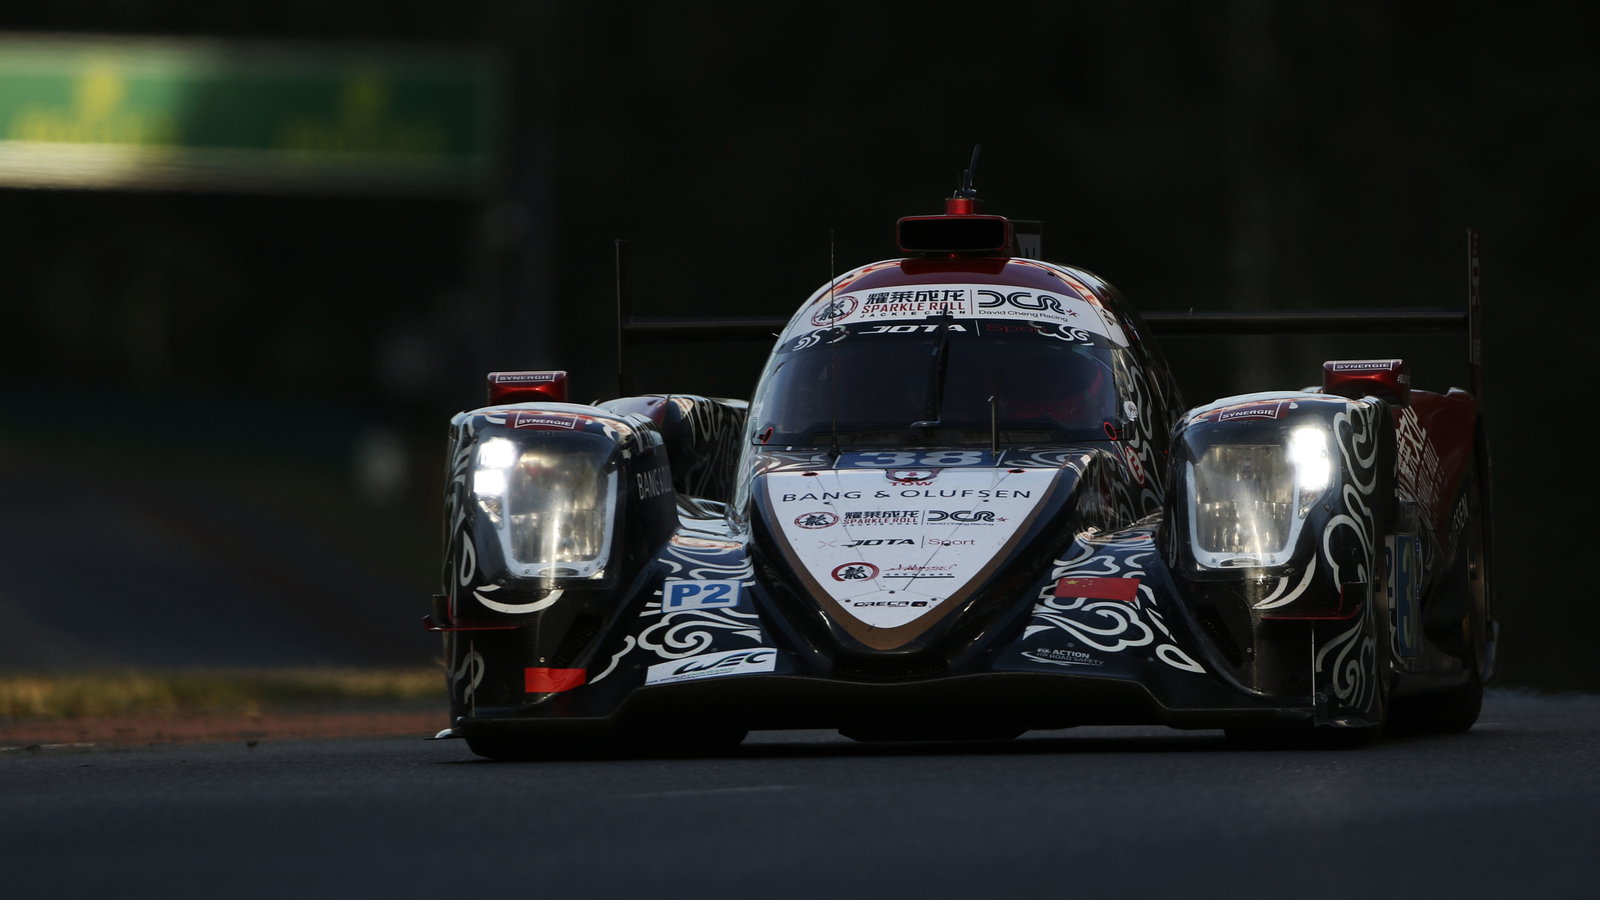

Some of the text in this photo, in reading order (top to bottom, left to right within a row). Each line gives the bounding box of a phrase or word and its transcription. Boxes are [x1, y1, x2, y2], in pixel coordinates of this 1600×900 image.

[865, 290, 965, 305] 耀莱成龙
[862, 302, 966, 314] SPARKLE ROLL
[1007, 310, 1039, 318] Cheng
[1039, 312, 1068, 322] Racing
[858, 324, 968, 334] JOTA
[1222, 408, 1275, 419] SYNERGIE
[518, 418, 572, 427] SYNERGIE
[853, 450, 984, 467] 38
[782, 489, 1031, 502] BANG & OLUFSEN
[841, 538, 975, 547] JOTA Sport
[670, 583, 732, 607] P2
[1053, 649, 1090, 659] ACTION
[672, 651, 776, 676] WEC
[1073, 657, 1104, 666] SAFETY
